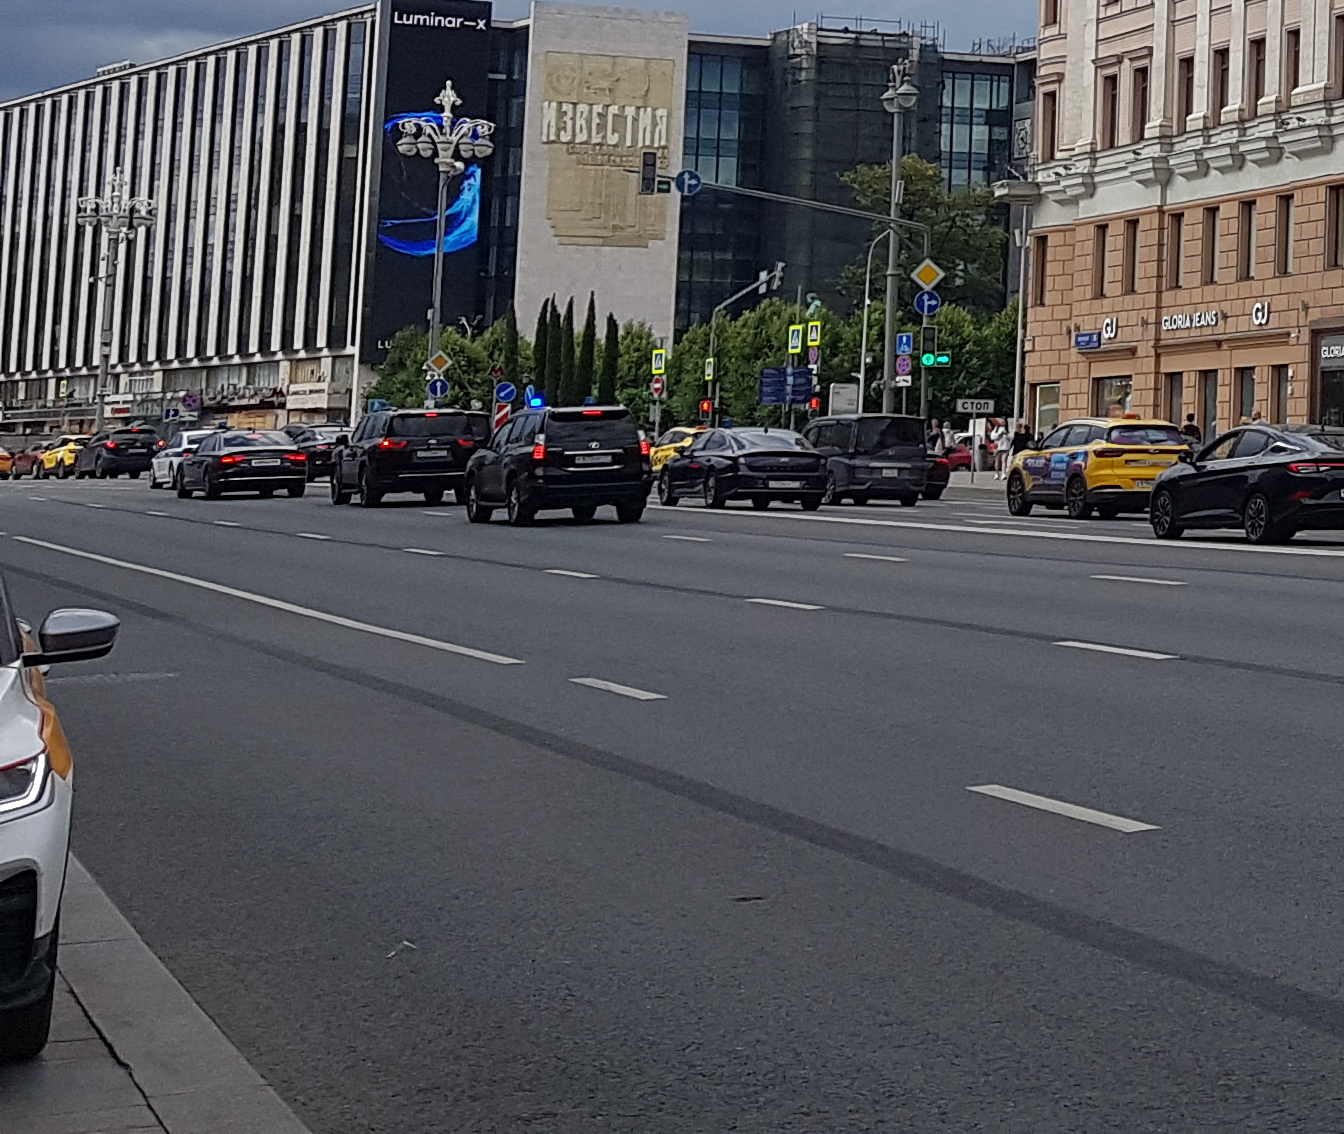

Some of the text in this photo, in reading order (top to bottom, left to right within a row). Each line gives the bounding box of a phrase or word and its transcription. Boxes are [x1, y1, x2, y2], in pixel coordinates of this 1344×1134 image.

[542, 101, 668, 148] ИЗВЕСТИЯ
[1162, 310, 1217, 330] GLORIA JEANS
[1252, 301, 1269, 325] GJ
[1102, 317, 1117, 339] GJ
[962, 401, 990, 411] СТОП
